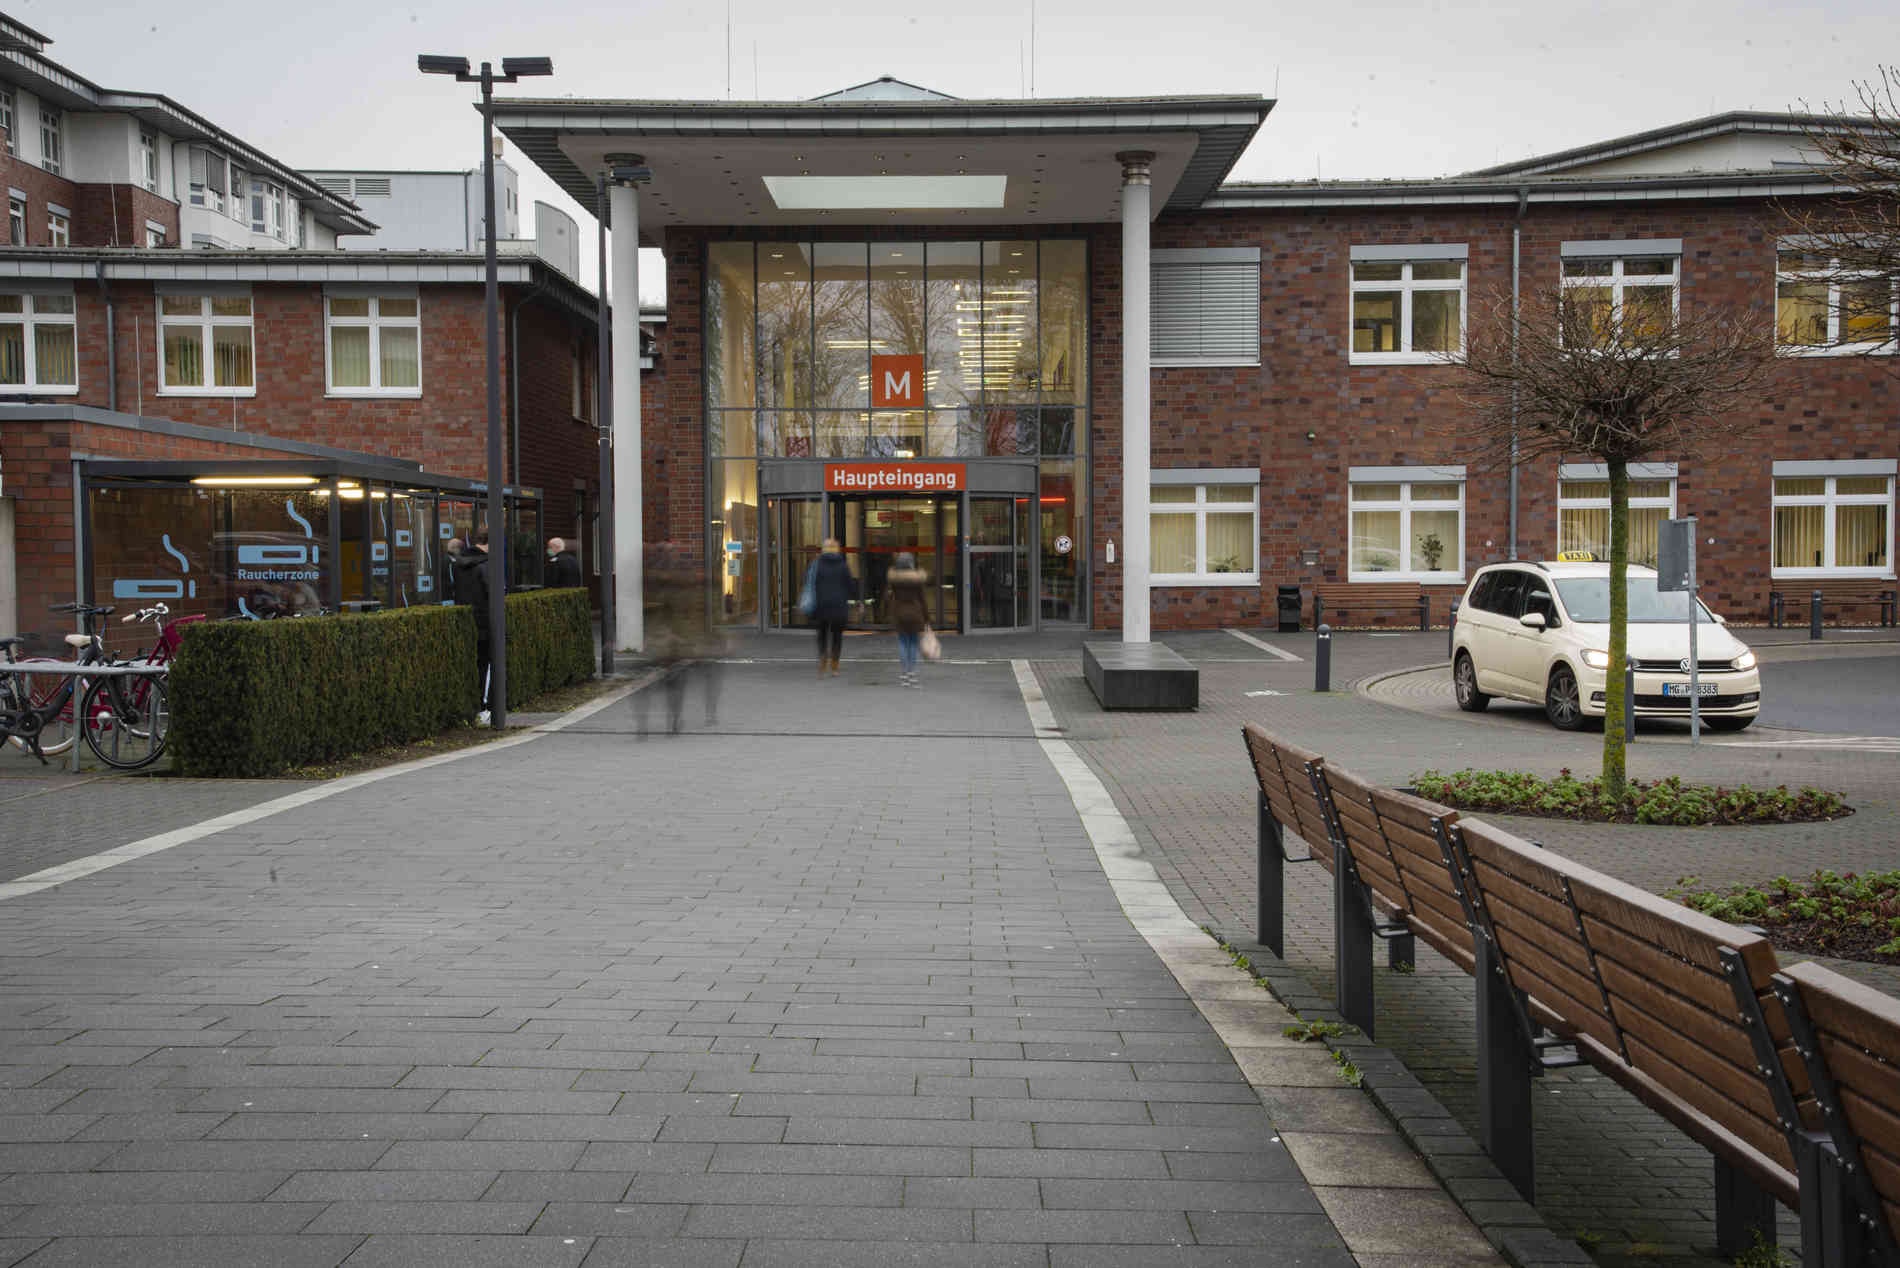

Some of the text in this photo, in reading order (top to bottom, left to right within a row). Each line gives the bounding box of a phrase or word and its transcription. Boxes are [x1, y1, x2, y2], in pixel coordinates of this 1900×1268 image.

[885, 370, 910, 400] M
[833, 468, 956, 489] Haupteingang
[1564, 551, 1592, 561] TAXI
[238, 568, 319, 580] Raucherzone
[1669, 684, 1680, 695] MG
